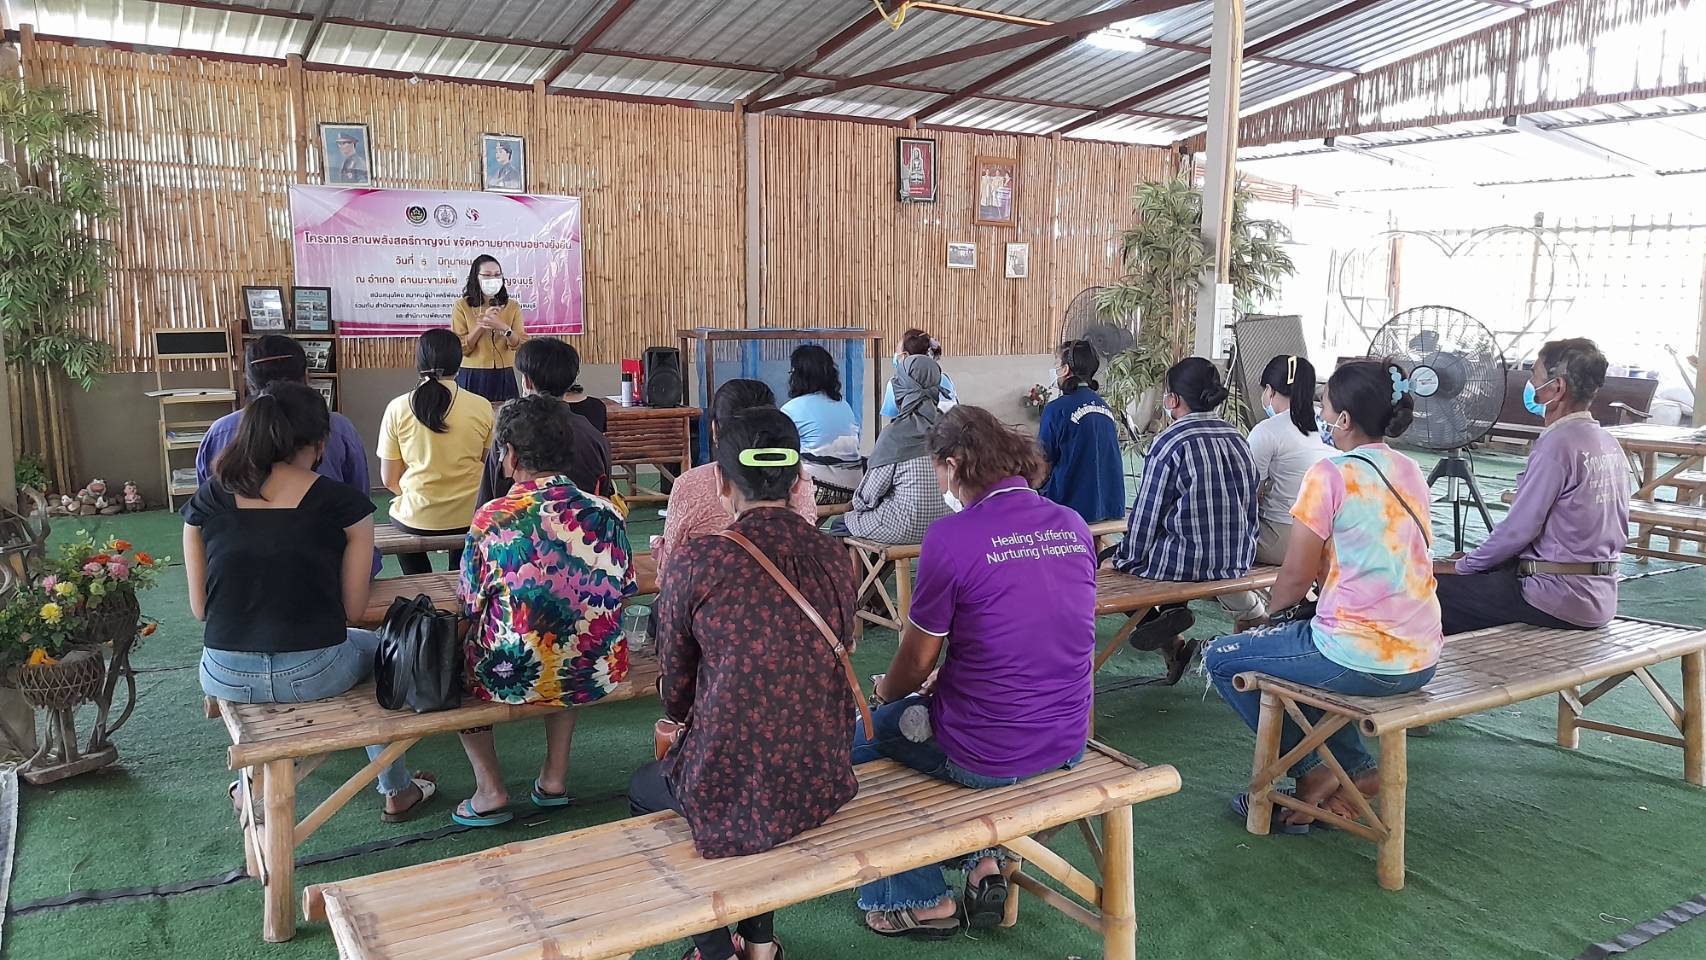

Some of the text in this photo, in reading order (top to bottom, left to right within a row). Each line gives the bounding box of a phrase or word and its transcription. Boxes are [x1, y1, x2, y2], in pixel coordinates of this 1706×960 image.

[304, 232, 572, 250] โครงการ สานพลังสตรีกาญจน์ ขจัดความยากจนอย่างยั่งยืน
[395, 253, 415, 265] วันที่
[355, 275, 366, 284] ณ
[367, 274, 395, 285] อำเภอ
[991, 529, 1077, 547] Healing Suffering
[986, 542, 1087, 564] Nurturing Happiness
